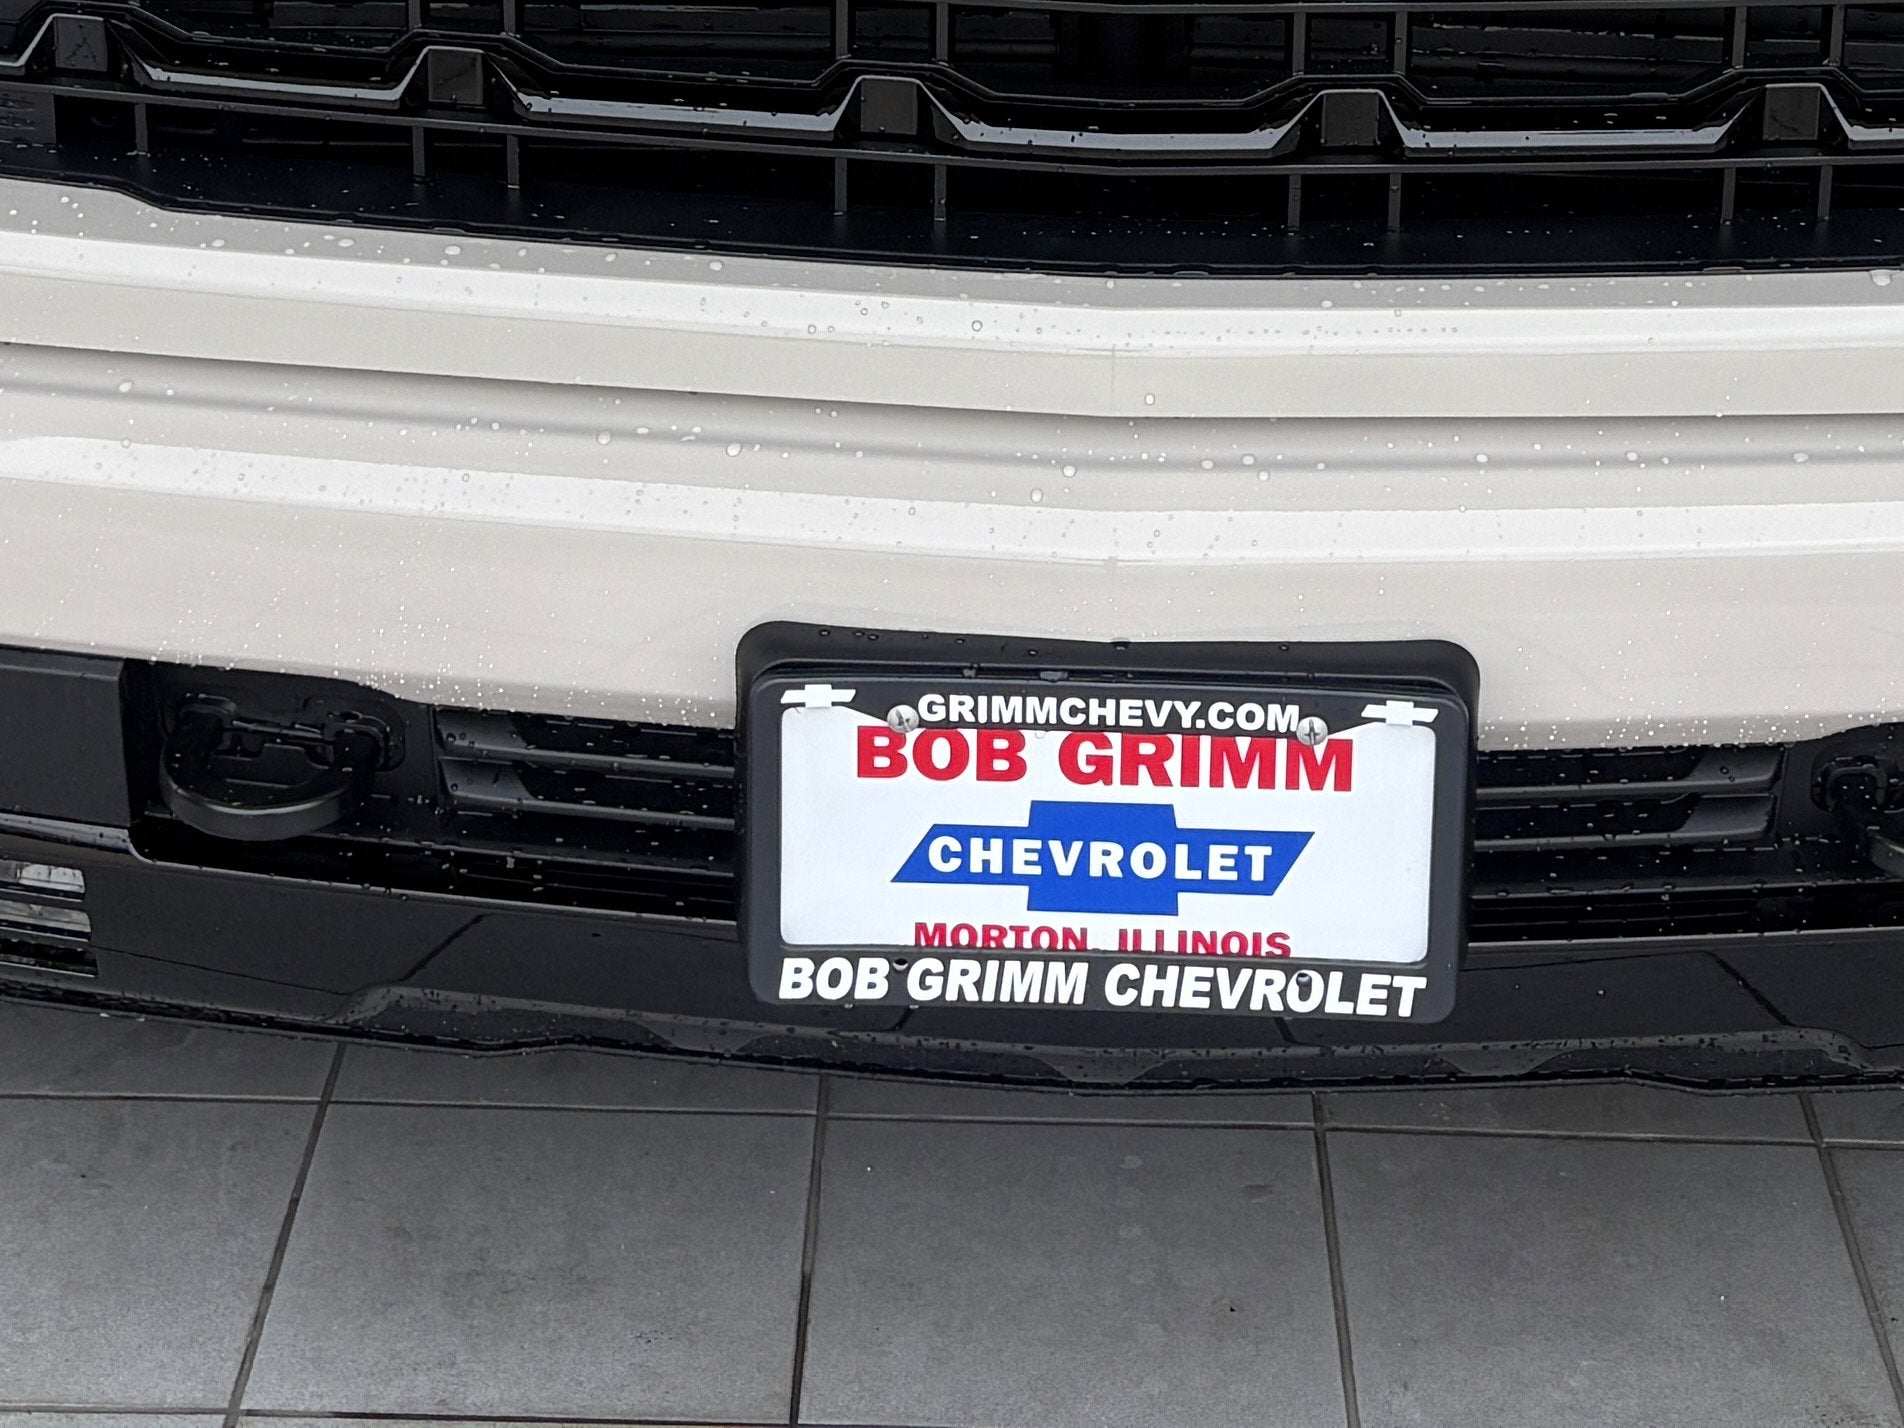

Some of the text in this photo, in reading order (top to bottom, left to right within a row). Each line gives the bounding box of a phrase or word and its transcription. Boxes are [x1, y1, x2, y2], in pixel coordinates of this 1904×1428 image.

[917, 694, 1300, 733] GRIMMCHEVY.COM
[856, 726, 1353, 792] BOB GRIMM
[927, 835, 1273, 882] CHEVROLET
[1118, 928, 1293, 958] ILLINOIS
[777, 957, 1427, 1018] BOB GRIMM CHEVROLET
